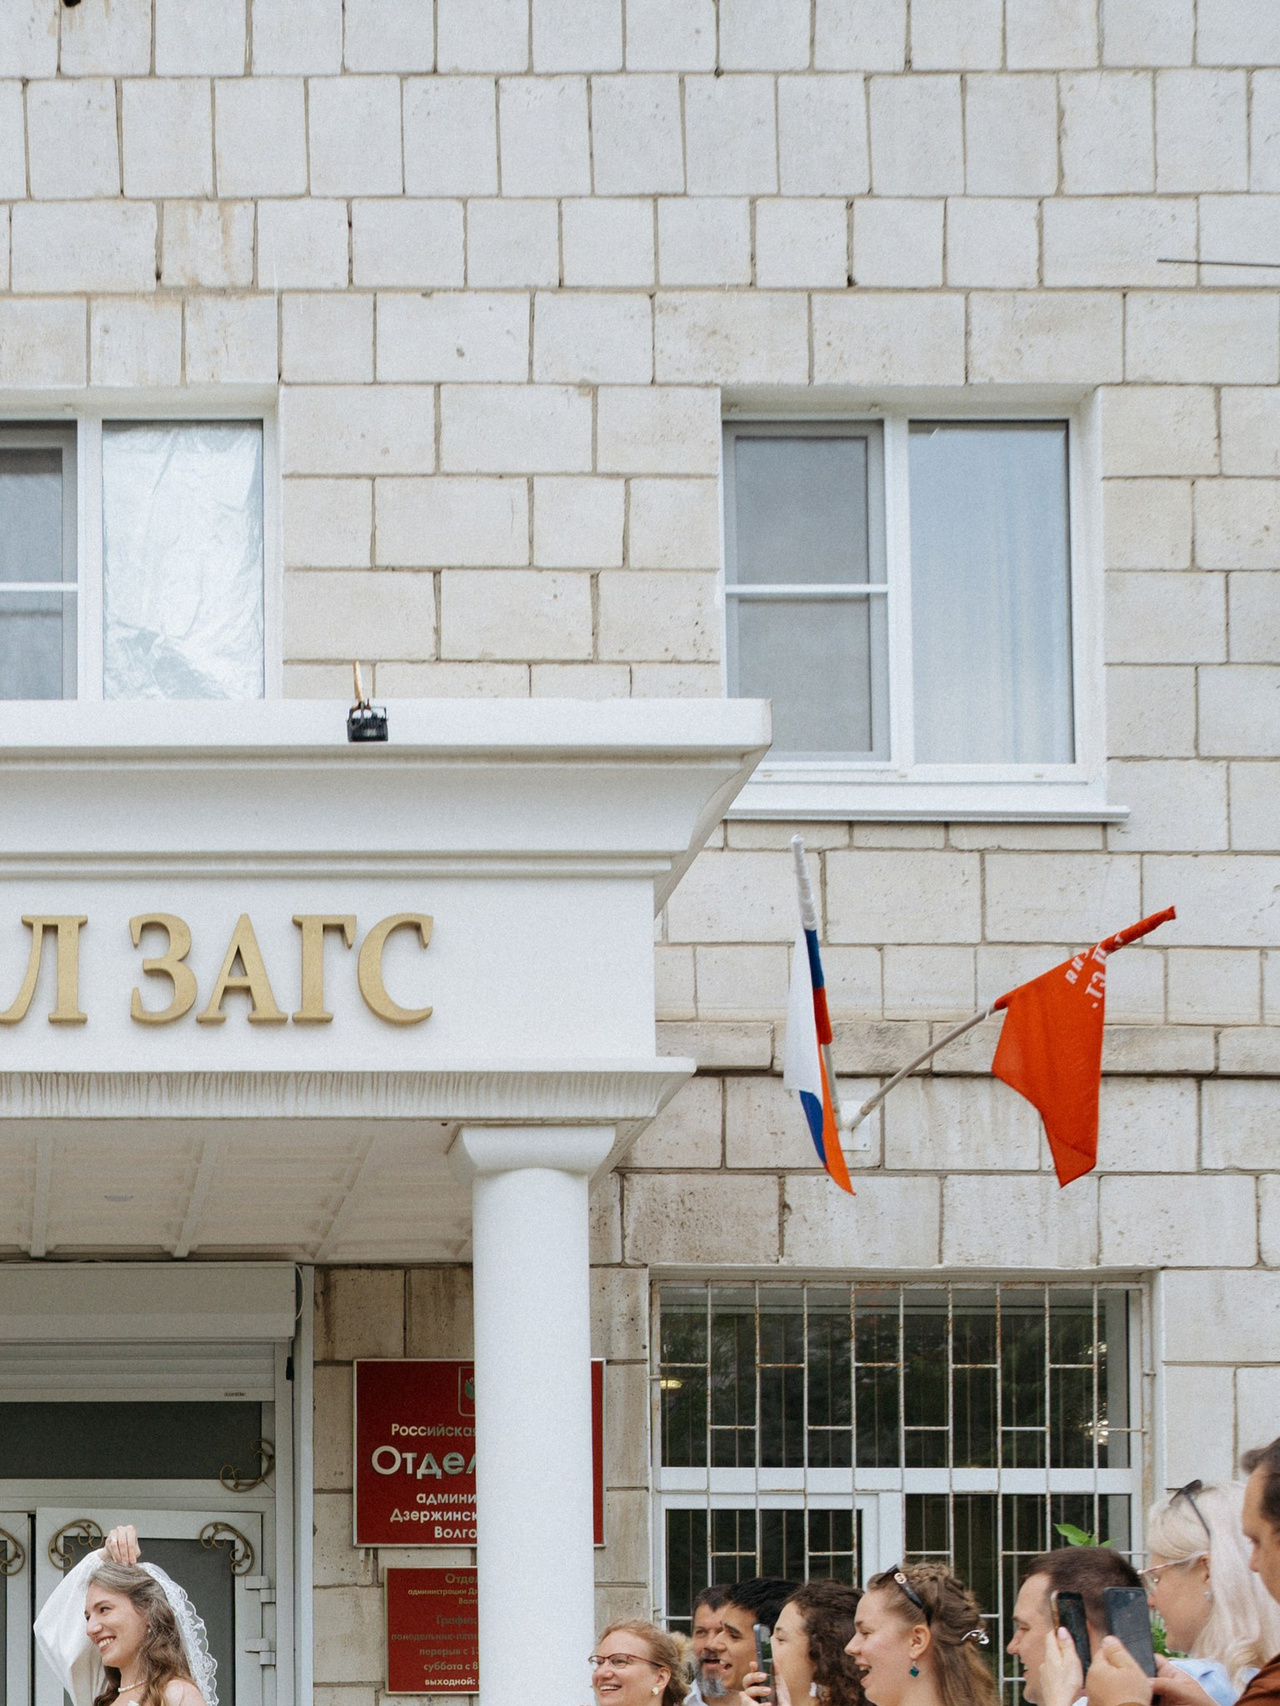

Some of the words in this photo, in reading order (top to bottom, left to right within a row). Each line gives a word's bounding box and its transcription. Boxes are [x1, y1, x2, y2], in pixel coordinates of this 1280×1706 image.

[128, 912, 435, 1025] ЗАГС
[416, 1493, 477, 1505] админи
[390, 1508, 477, 1523] Дзержинск
[434, 1526, 477, 1538] Волго
[423, 1661, 463, 1672] суббота
[425, 1676, 476, 1686] выходной:
